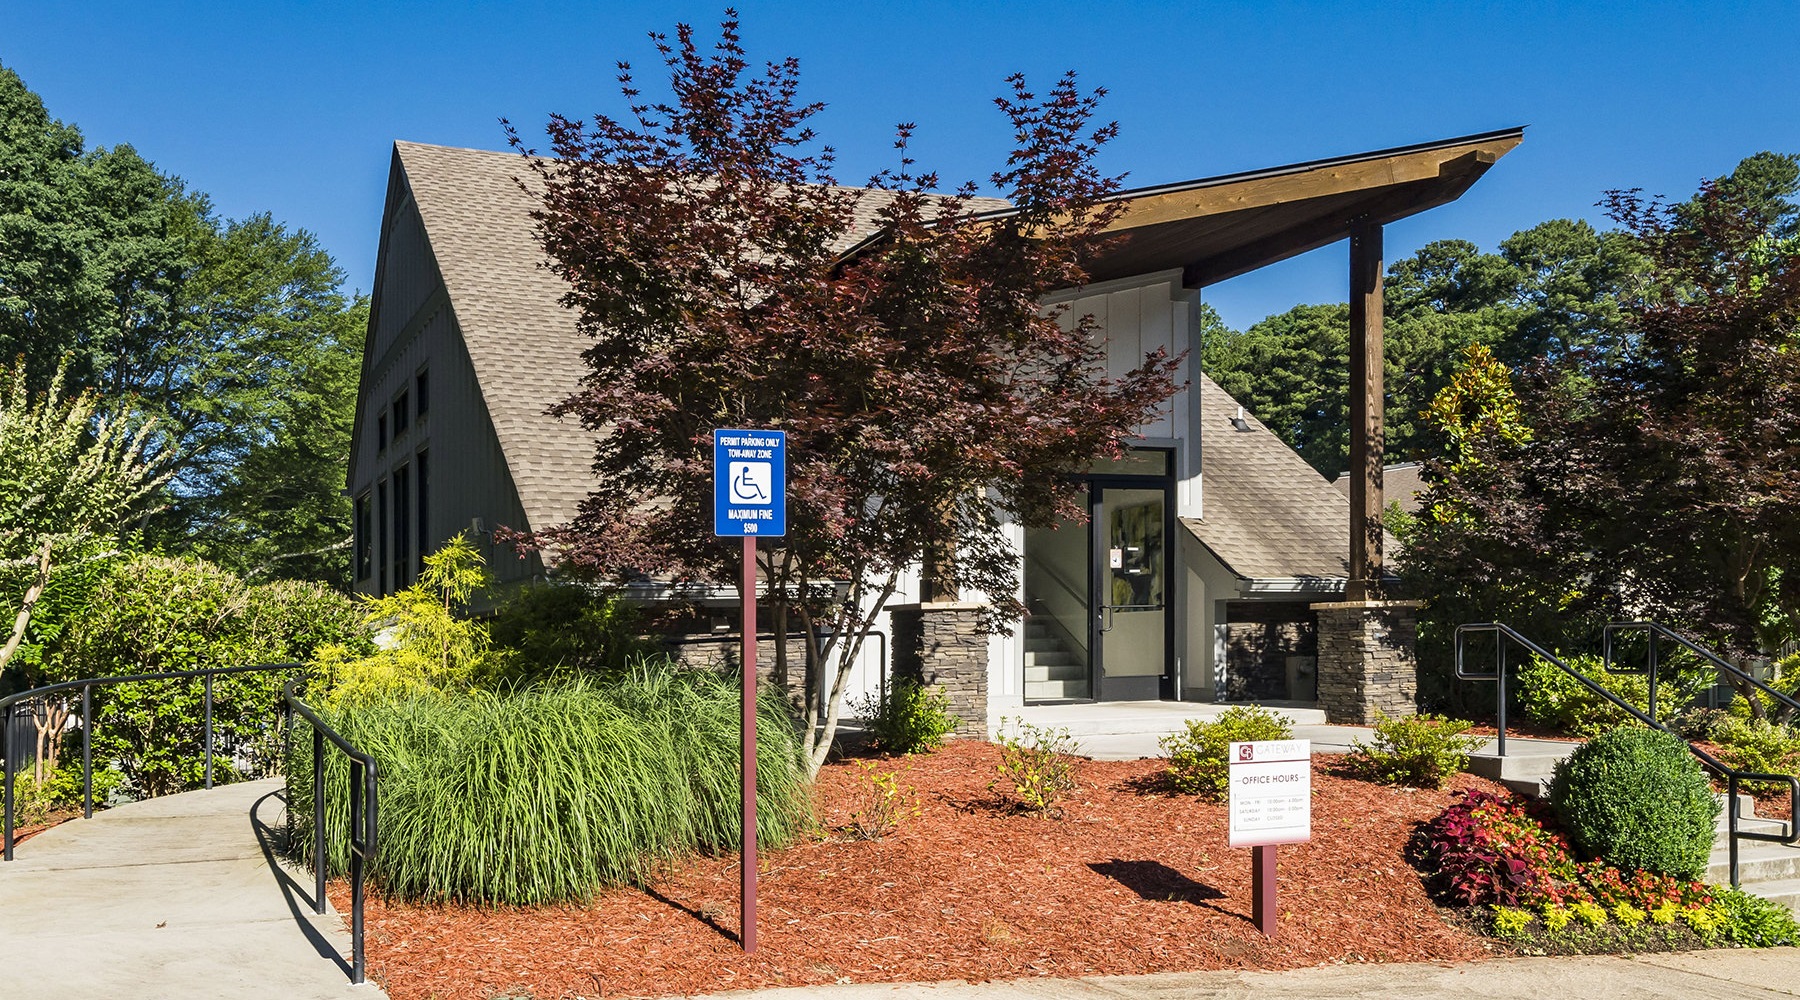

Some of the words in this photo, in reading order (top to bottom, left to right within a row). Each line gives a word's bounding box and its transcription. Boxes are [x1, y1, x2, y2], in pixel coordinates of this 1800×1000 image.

[720, 437, 740, 446] PERMIT
[741, 437, 764, 447] PARKING
[765, 438, 780, 447] ONLY
[728, 449, 757, 458] TOW-AWAY
[757, 449, 772, 459] ZONE
[728, 509, 758, 520] MAXIMUM
[758, 509, 773, 520] FINE
[743, 522, 758, 534] $500
[1256, 743, 1302, 755] GATEWAY
[1242, 776, 1270, 785] OFFICE
[1272, 774, 1299, 783] HOURS
